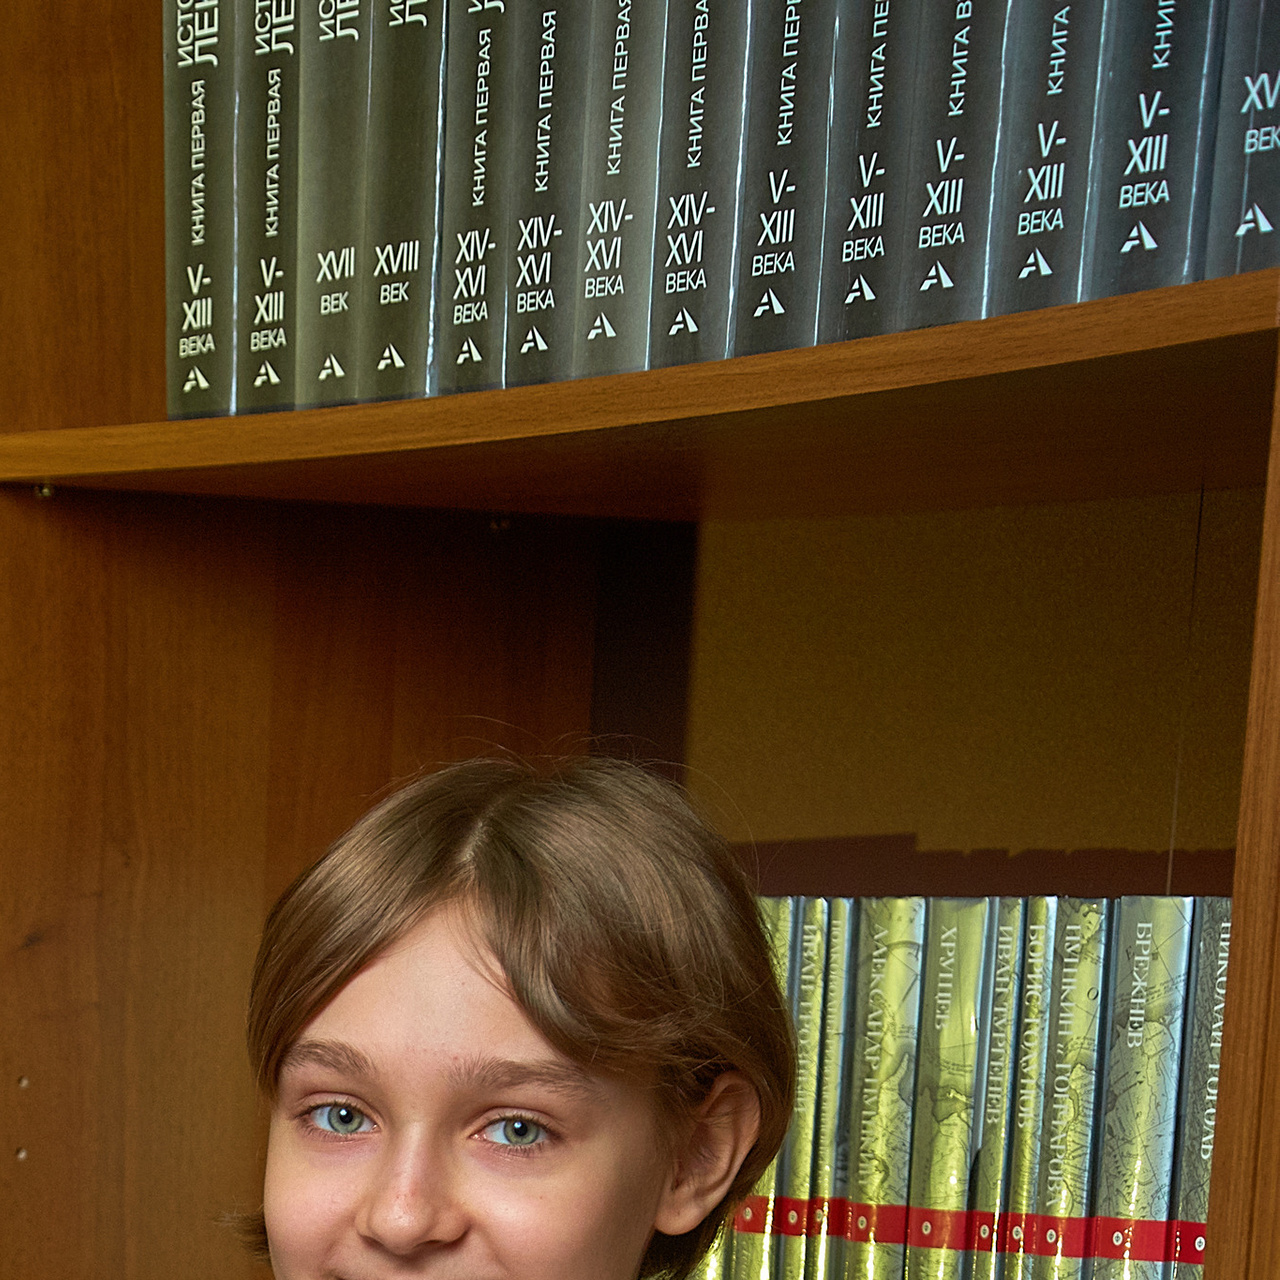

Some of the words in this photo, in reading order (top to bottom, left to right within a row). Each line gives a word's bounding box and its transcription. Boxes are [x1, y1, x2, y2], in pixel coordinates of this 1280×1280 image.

[194, 0, 219, 68] ЛЕ
[1046, 5, 1071, 96] КНИГА
[475, 28, 492, 126] ПЕРВАЯ
[538, 10, 557, 110] ПЕРВАЯ
[947, 25, 971, 117] КНИГА
[776, 61, 798, 146] КНИГА
[866, 42, 887, 129] КНИГА
[191, 79, 206, 171] ПЕРВАЯ
[266, 68, 282, 161] ПЕРВАЯ
[606, 95, 626, 176] КНИГА
[686, 86, 706, 169] КНИГА
[472, 129, 488, 207] КНИГА
[534, 113, 552, 193] КНИГА
[1123, 133, 1169, 176] XIII
[265, 163, 280, 238] КНИГА
[922, 177, 964, 218] XIII
[1023, 162, 1065, 203] XIII
[1118, 179, 1170, 209] ВЕКА
[191, 172, 205, 246] КНИГА
[757, 208, 795, 247] XIII
[847, 192, 885, 232] XIII
[1017, 207, 1064, 236] ВЕКА
[583, 236, 622, 273] XVI
[664, 229, 704, 268] XVI
[841, 235, 885, 263] ВЕКА
[918, 221, 965, 249] ВЕКА
[316, 246, 355, 283] XVII
[373, 239, 420, 277] XVIII
[515, 251, 552, 288] XVI
[751, 250, 795, 277] ВЕКА
[320, 290, 349, 315] ВЕК
[379, 281, 410, 305] ВЕК
[452, 264, 486, 301] XVI
[516, 288, 555, 314] ВЕКА
[584, 274, 625, 299] ВЕКА
[665, 268, 707, 294] ВЕКА
[181, 296, 213, 332] XIII
[253, 290, 284, 325] XIII
[453, 300, 489, 325] ВЕКА
[178, 333, 216, 358] ВЕКА
[250, 327, 287, 352] ВЕКА
[933, 925, 958, 1031] ХРУЩЕВ
[993, 924, 1015, 994] ИВАН
[1024, 923, 1047, 1006] БОРИС
[1056, 923, 1082, 1036] ПУШКИН
[862, 923, 890, 1071] АЛЕКСАНДР
[1126, 921, 1154, 1049] БРЕЖНЕВ
[985, 1001, 1009, 1125] ТУРГЕНЕВ
[1016, 1017, 1042, 1129] ГОДУНОВ
[857, 1079, 880, 1187] ПУШКИН
[1045, 1062, 1072, 1208] ГОНЧАРОВА
